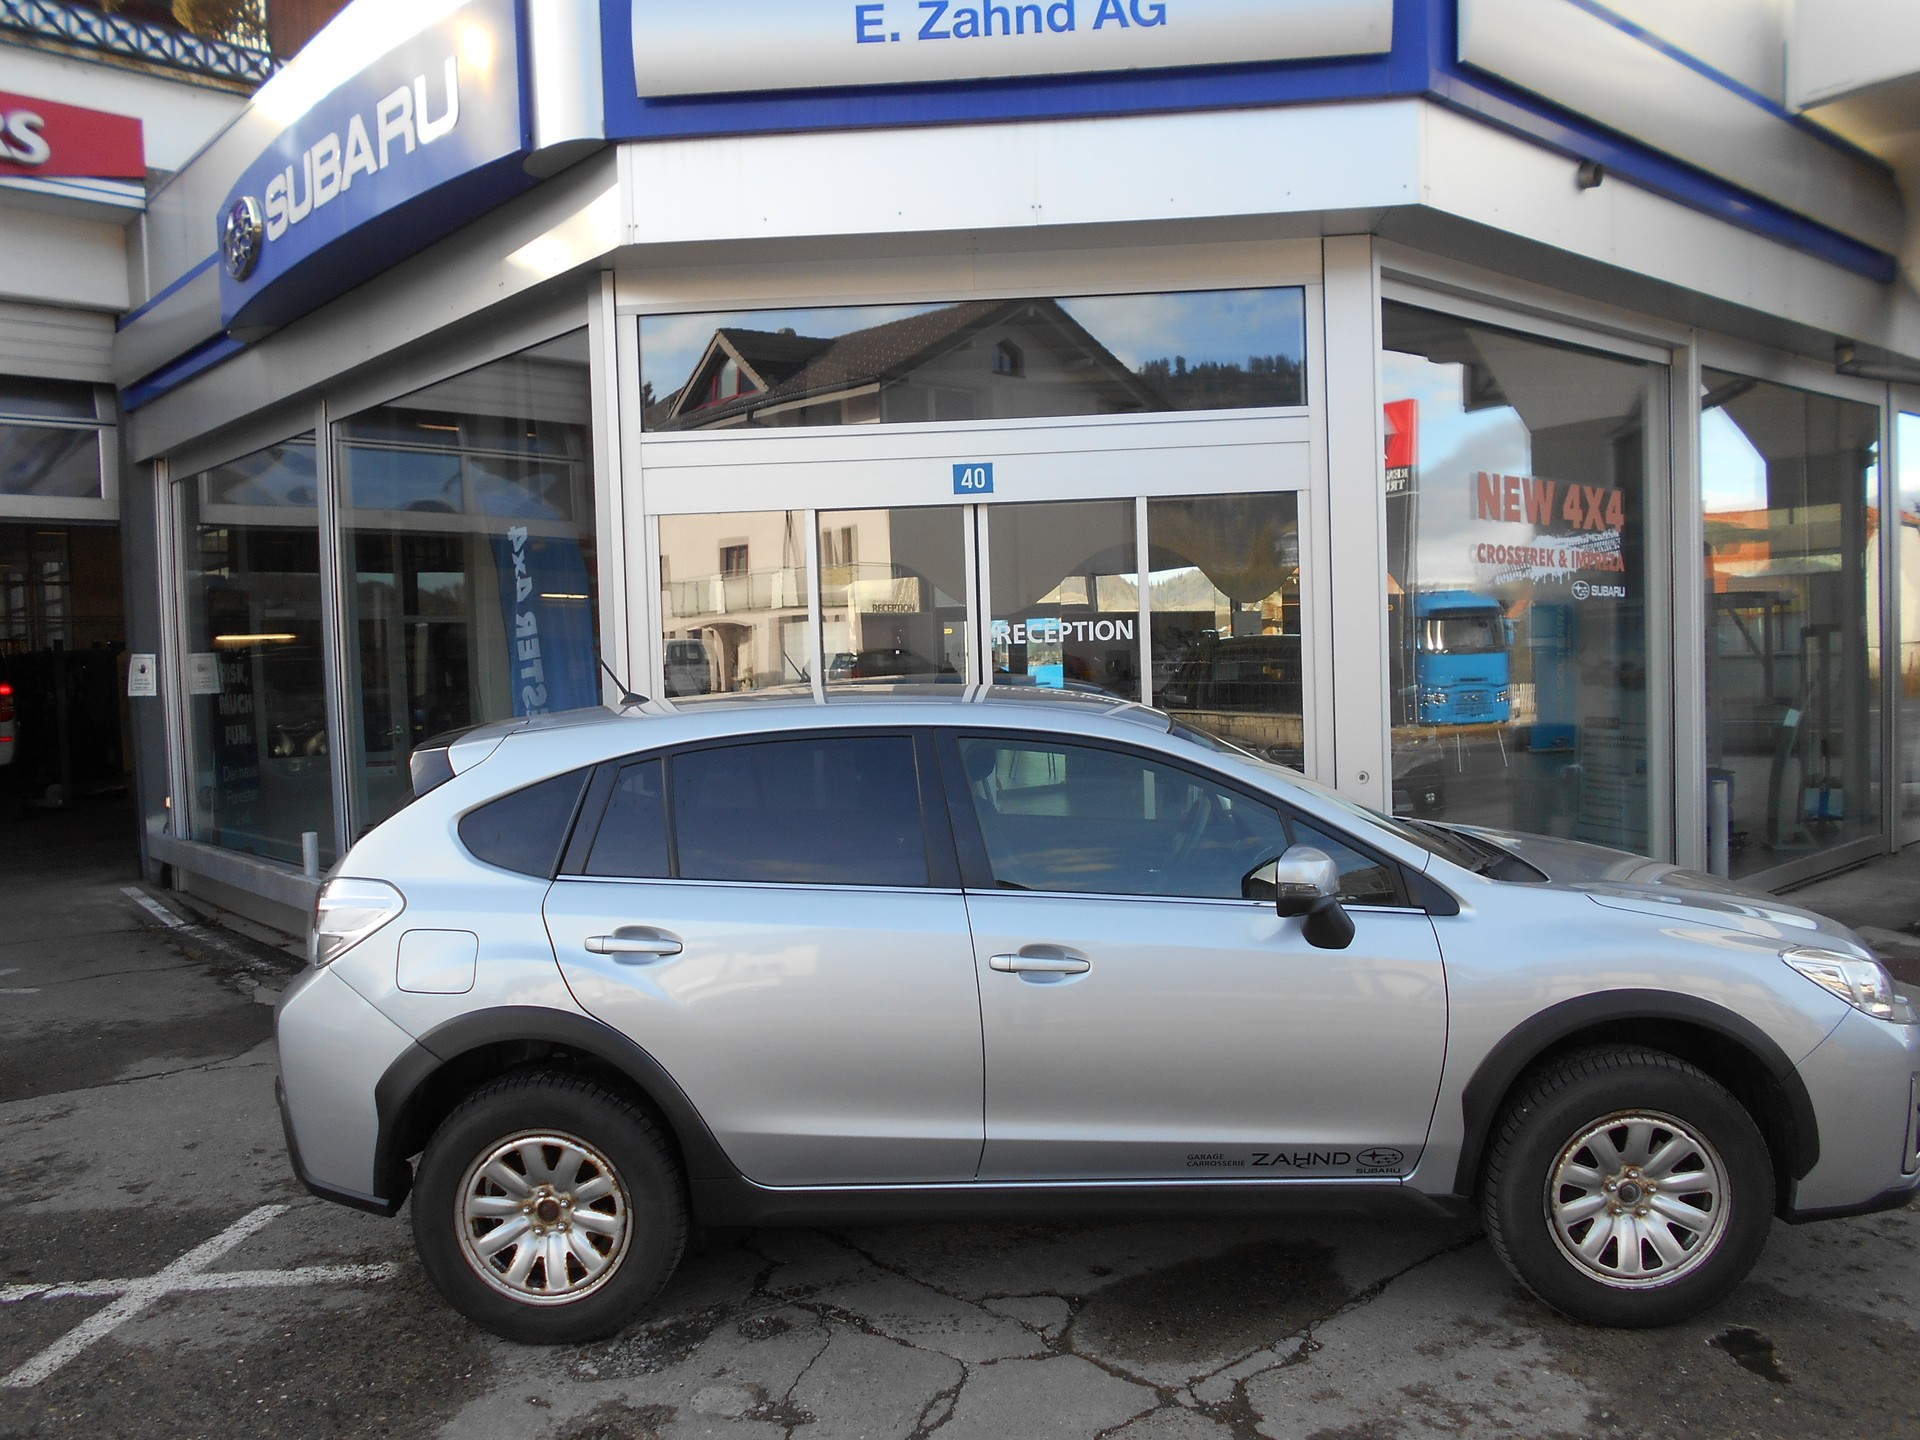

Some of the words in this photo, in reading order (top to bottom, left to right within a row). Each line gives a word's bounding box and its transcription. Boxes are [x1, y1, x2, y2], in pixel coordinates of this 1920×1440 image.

[855, 3, 900, 43] E.
[918, 0, 1076, 40] Zahnd
[1092, 0, 1167, 30] AG
[265, 55, 459, 242] SUBARU
[961, 467, 986, 489] 40
[1477, 471, 1555, 526] NEW
[1562, 483, 1625, 532] 4X4
[1477, 543, 1555, 567] CROSSTREK
[1558, 551, 1567, 567] &
[1571, 551, 1625, 572] IMPREZA
[1591, 585, 1625, 597] SUBARU
[872, 603, 915, 612] RECEPTION
[996, 619, 1134, 645] RECEPTION
[219, 693, 253, 715] MUCH
[225, 724, 252, 746] FUN.
[1252, 1152, 1351, 1170] ZAHND
